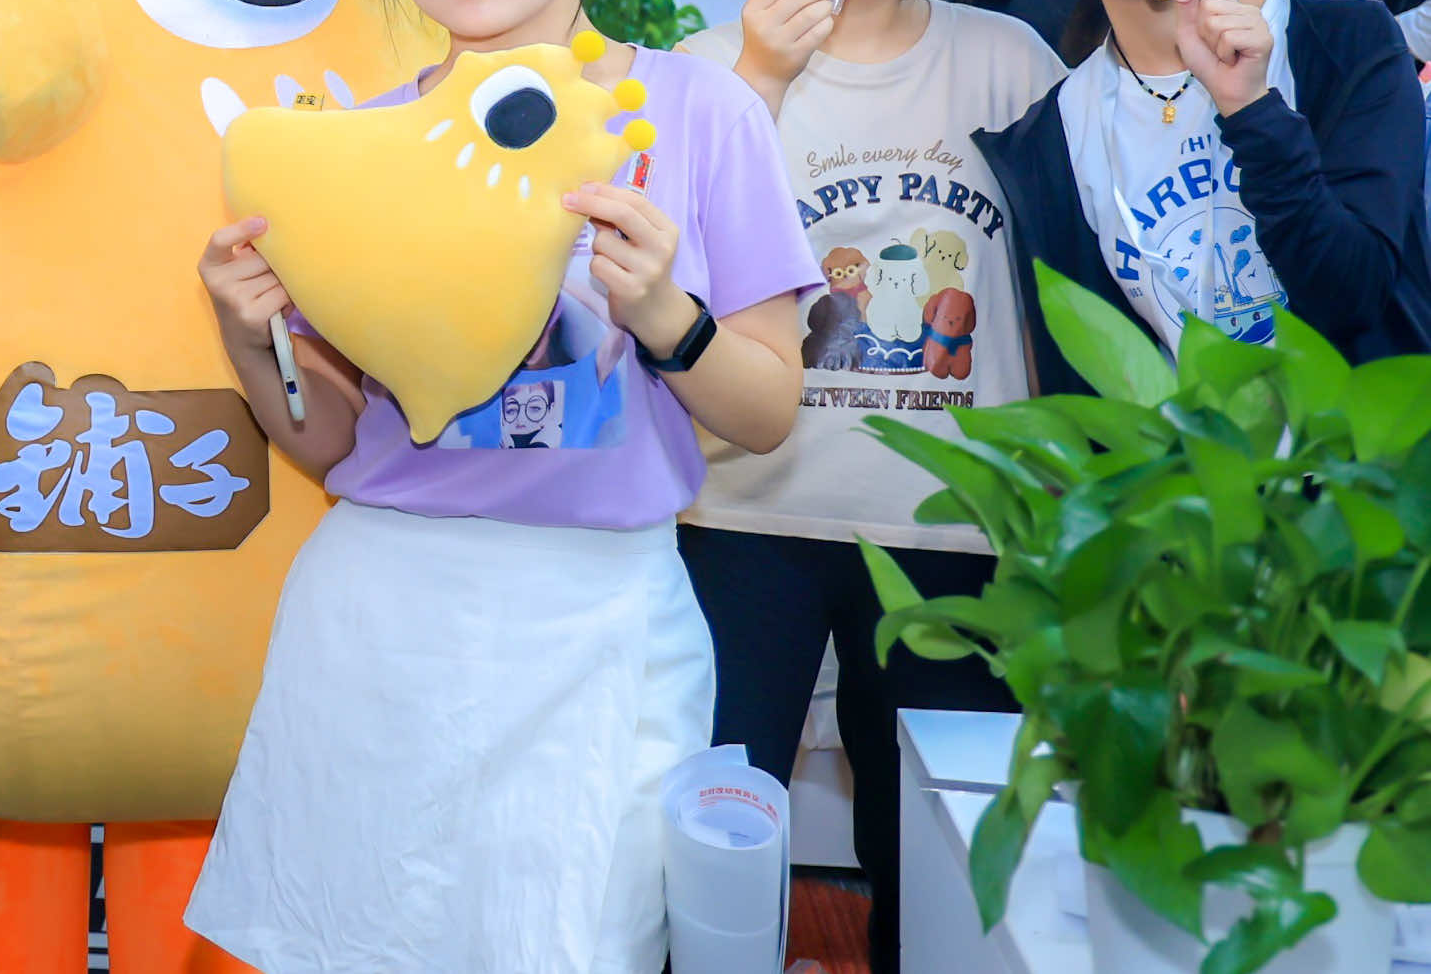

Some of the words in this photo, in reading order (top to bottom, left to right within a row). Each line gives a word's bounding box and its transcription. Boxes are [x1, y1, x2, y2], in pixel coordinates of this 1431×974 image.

[806, 143, 858, 178] Smile
[862, 146, 920, 168] every
[923, 139, 964, 175] day
[795, 175, 883, 230] APPY
[897, 172, 1004, 241] PARTY
[799, 387, 891, 410] ETWEEN
[896, 389, 974, 411] FRIENDS
